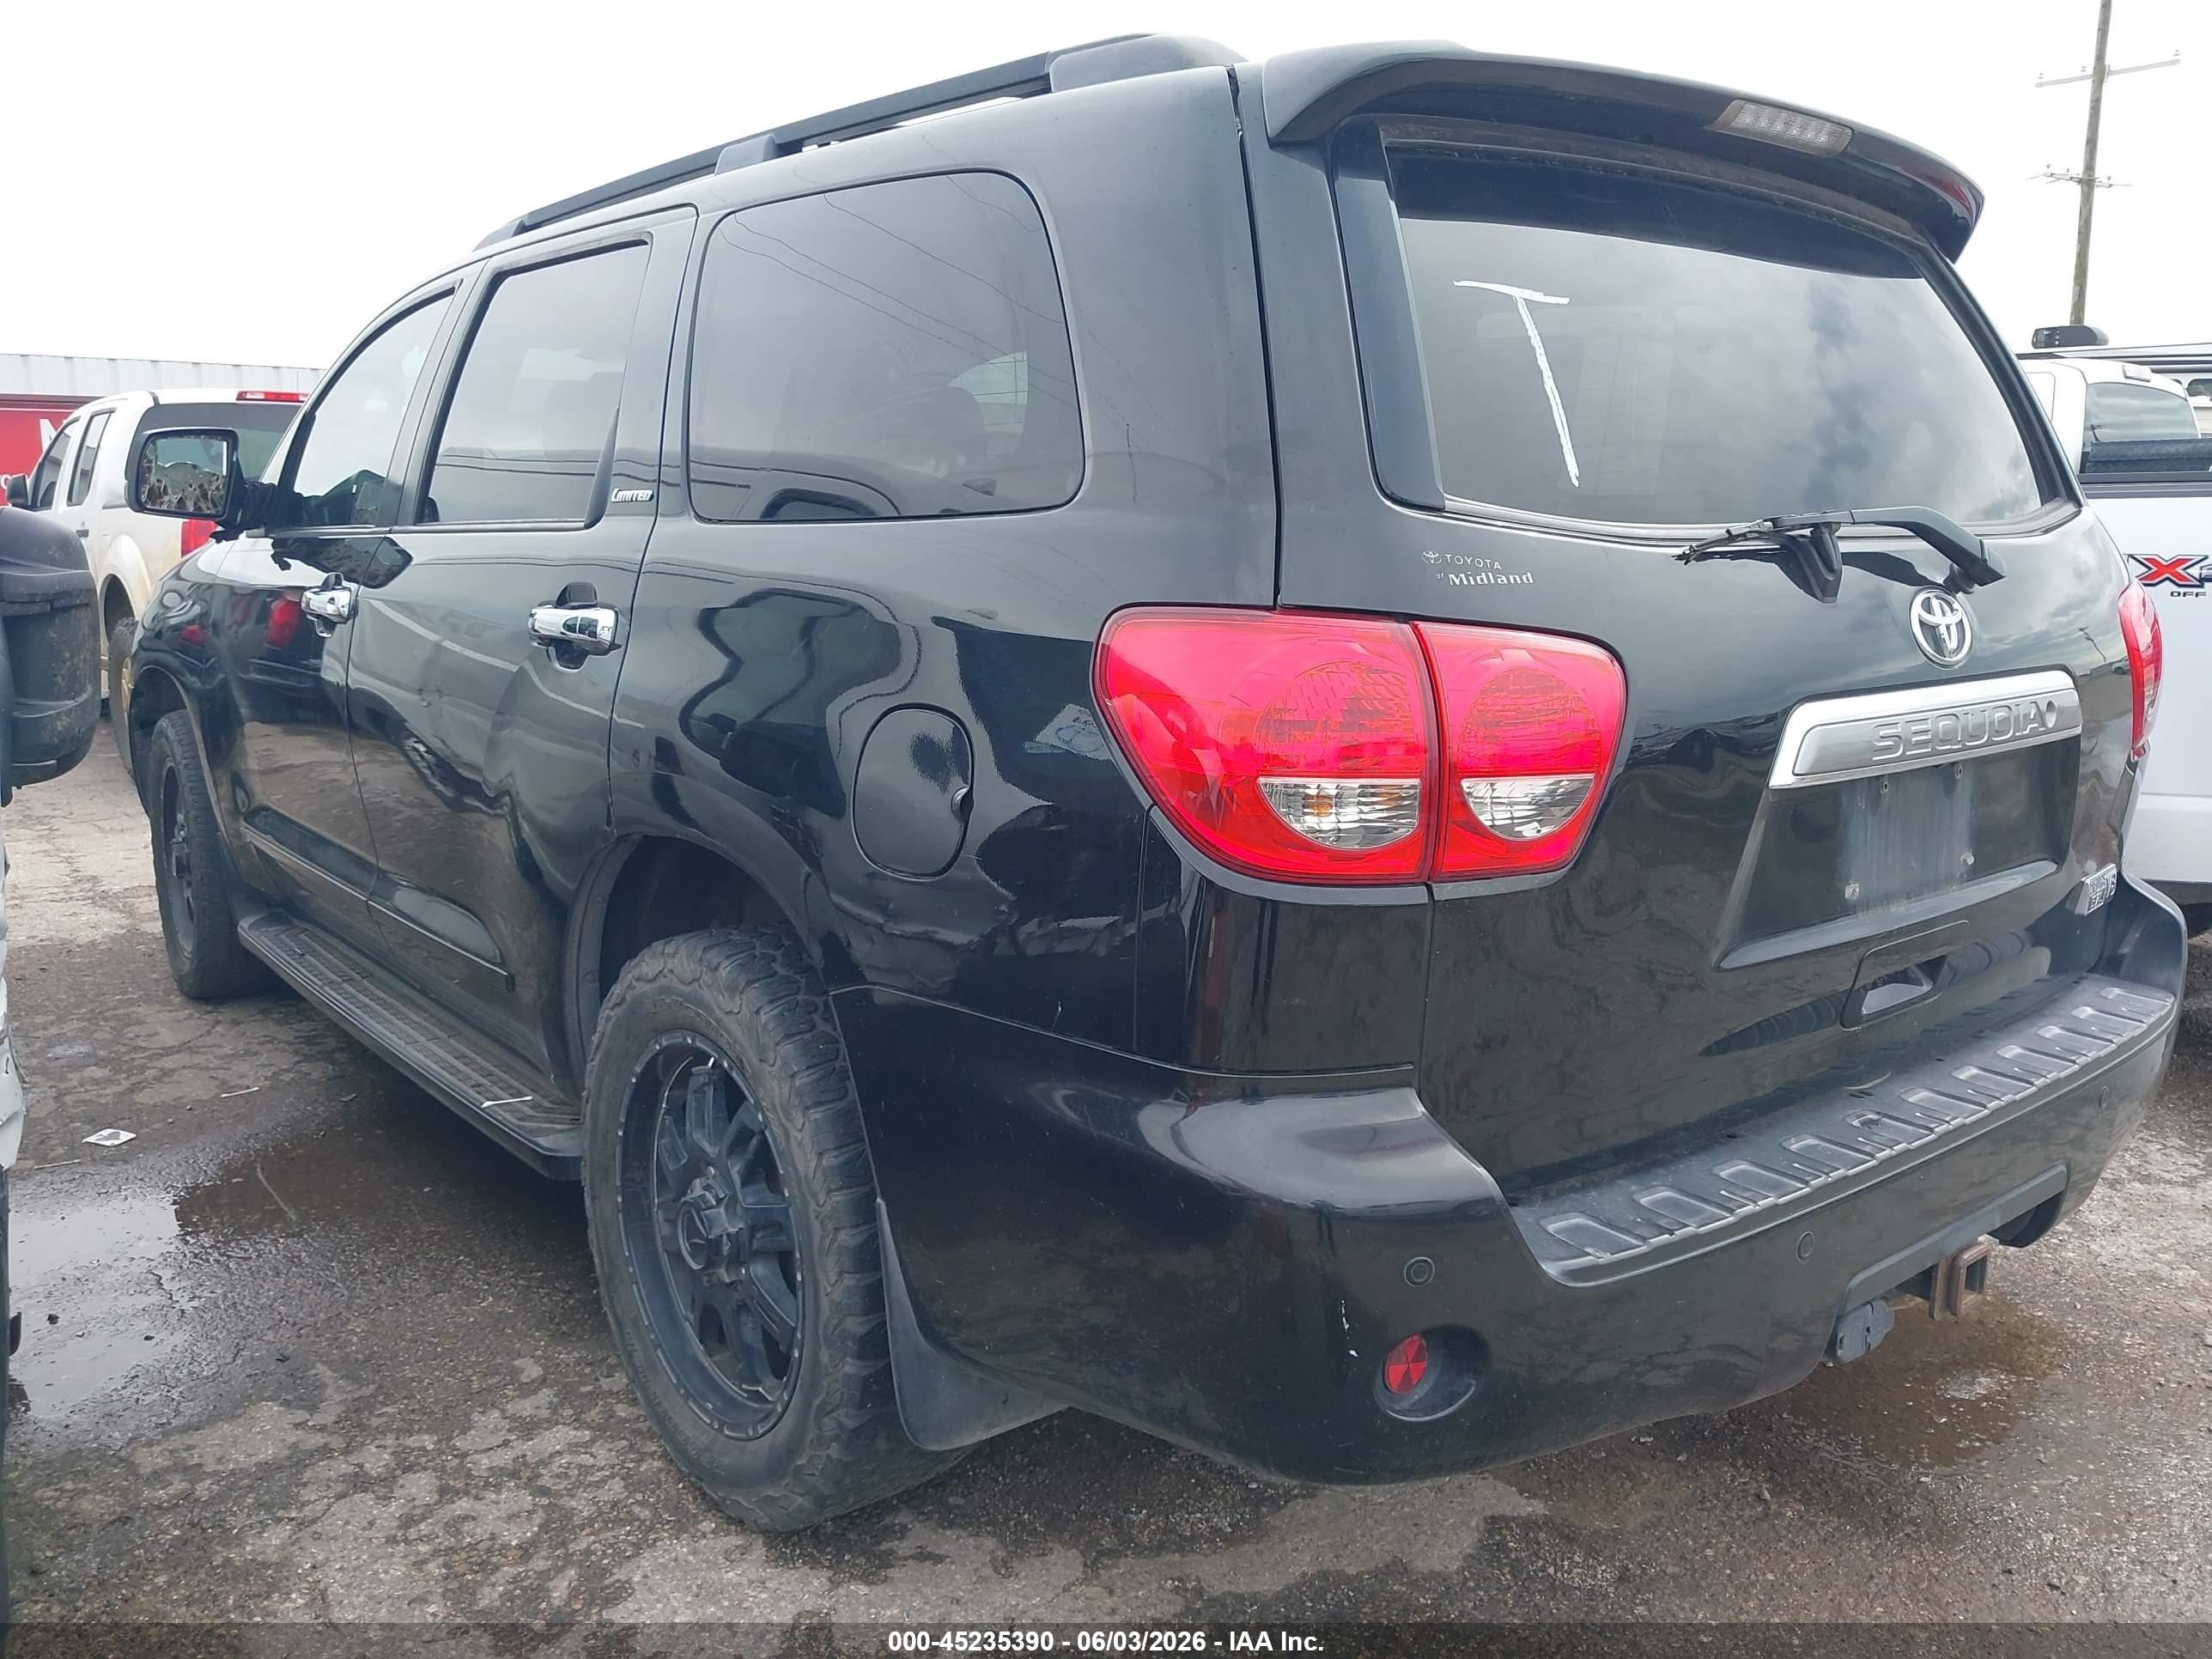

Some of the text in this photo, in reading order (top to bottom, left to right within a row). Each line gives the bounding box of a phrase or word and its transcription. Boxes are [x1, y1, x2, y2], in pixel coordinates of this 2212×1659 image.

[1444, 553, 1503, 570] TOYOTA
[1448, 571, 1534, 586] Midland
[1871, 700, 2046, 761] SEQUOIA
